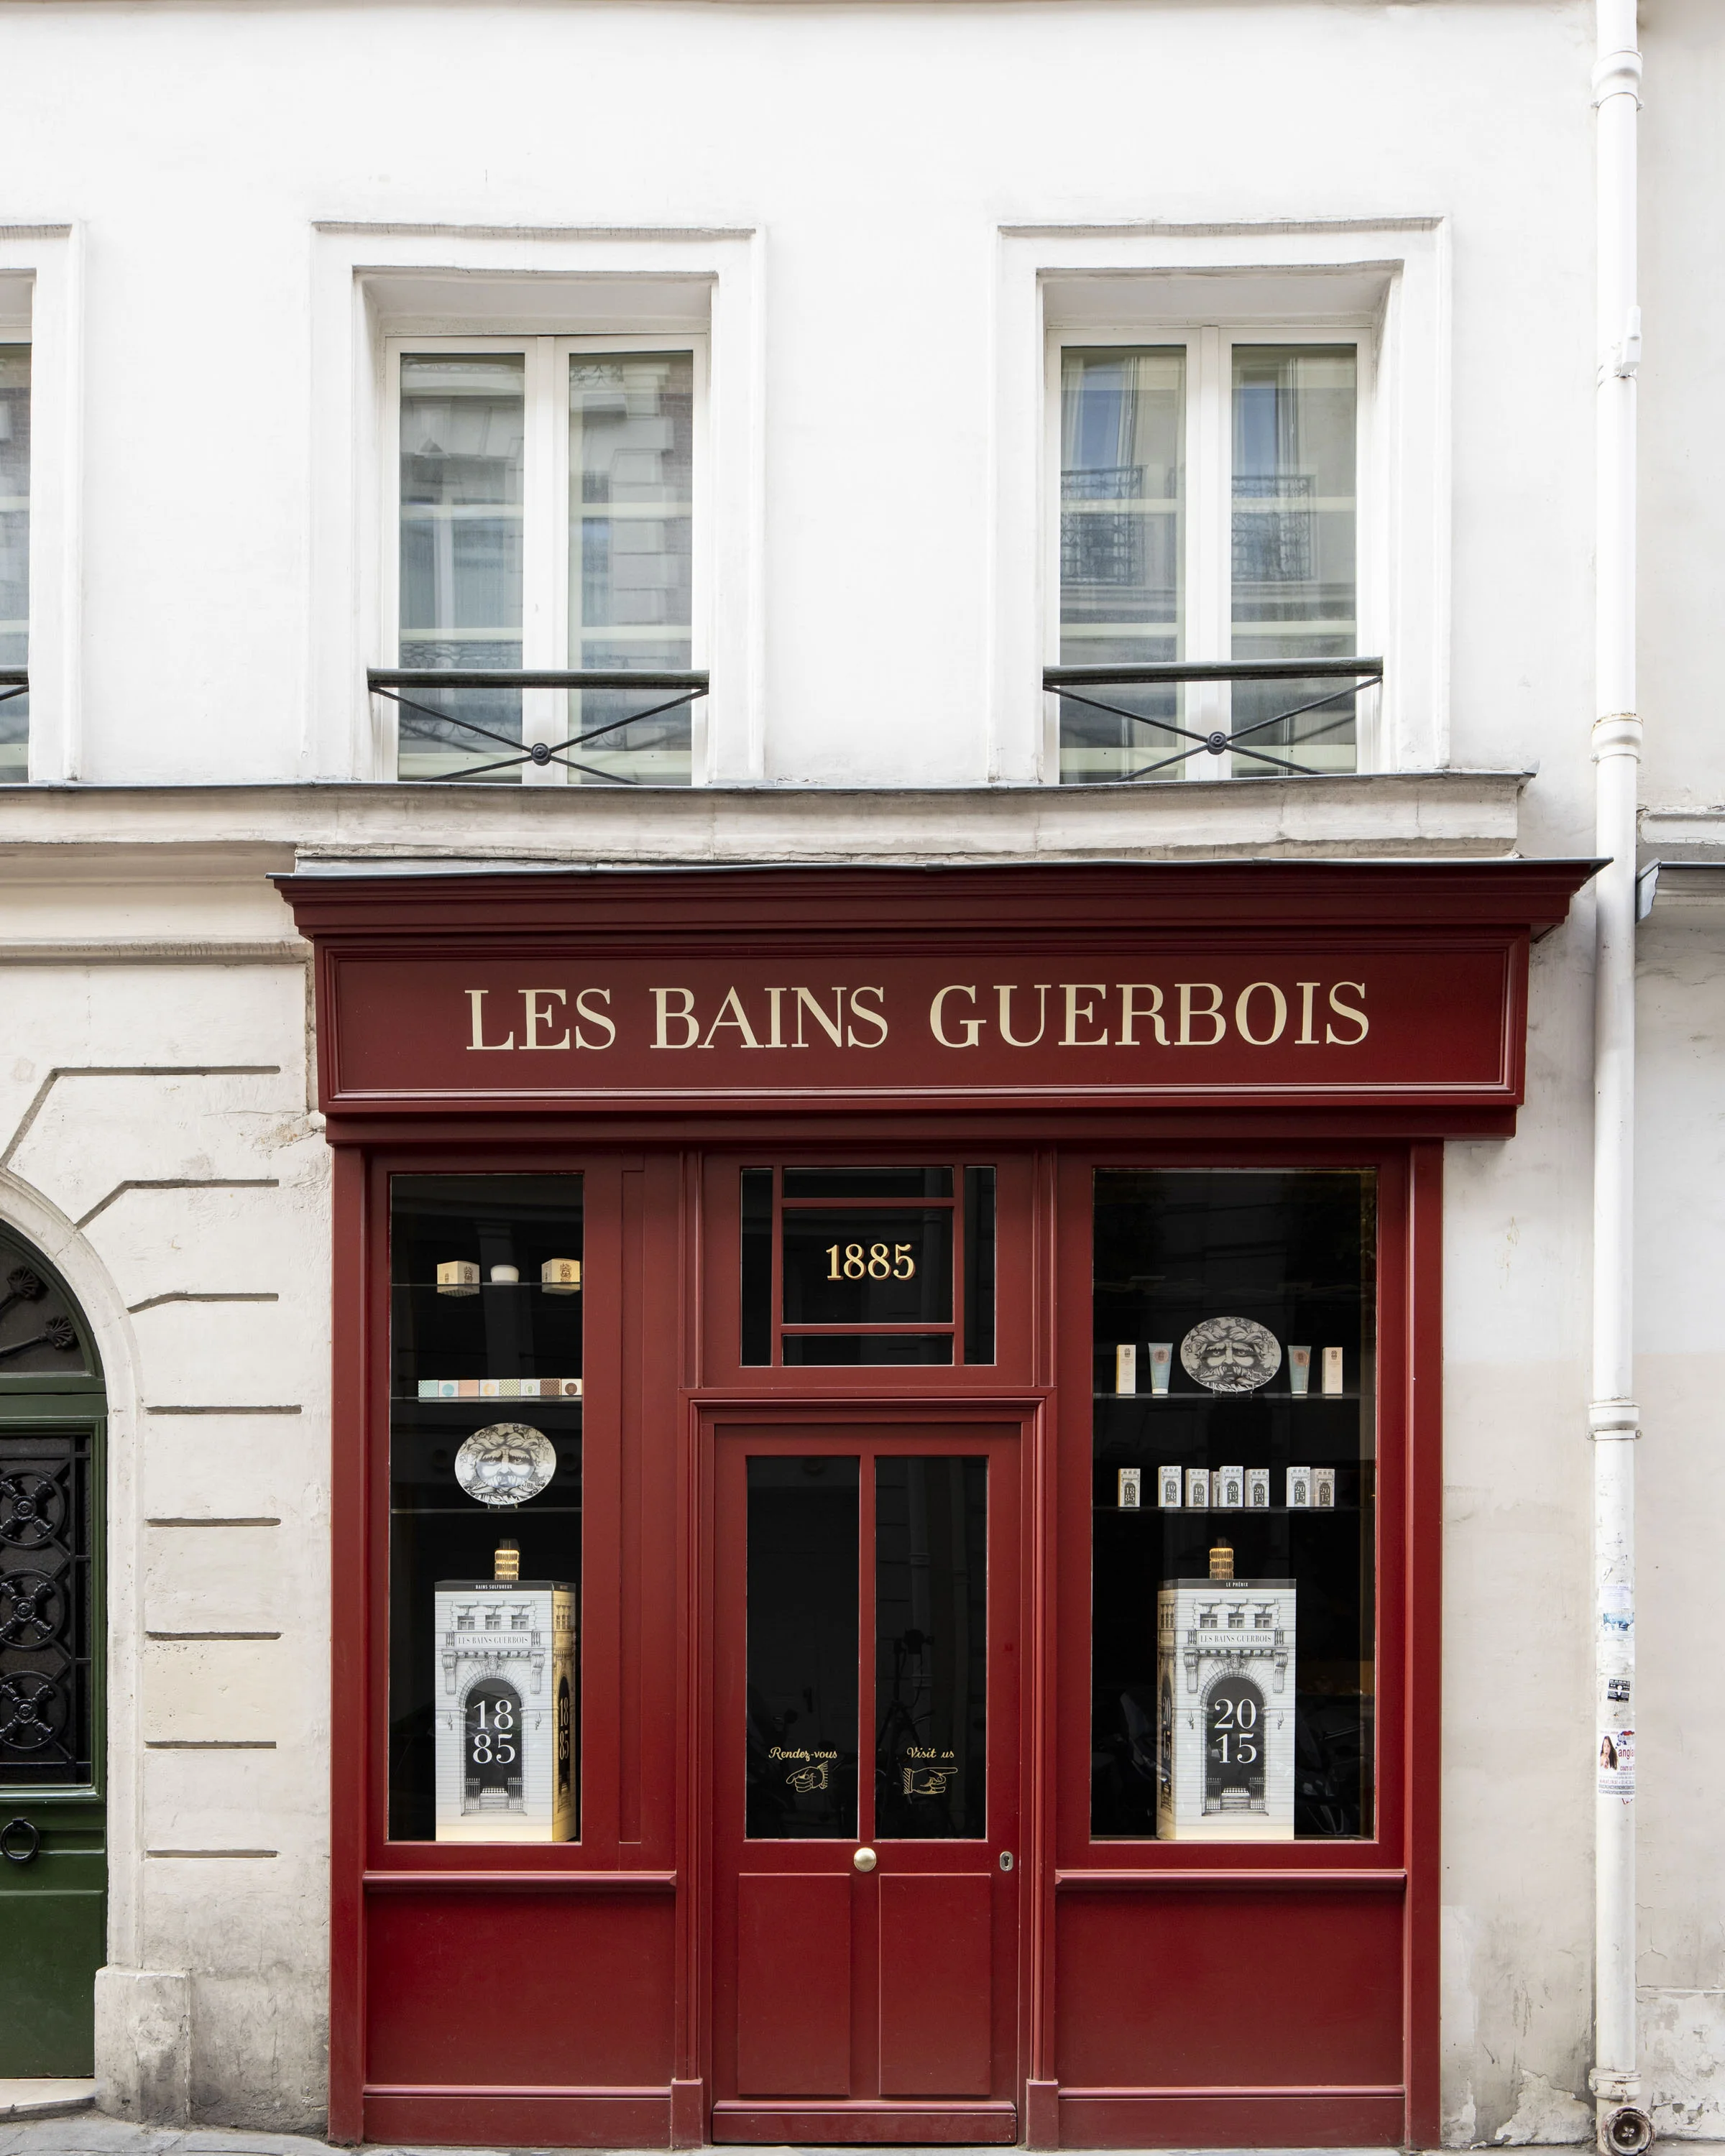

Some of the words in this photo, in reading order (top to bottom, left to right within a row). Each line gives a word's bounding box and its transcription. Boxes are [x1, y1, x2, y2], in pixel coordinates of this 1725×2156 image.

[464, 987, 616, 1050] LES
[649, 985, 888, 1049] BAINS
[929, 981, 1369, 1048] GUERBOIS
[826, 1243, 916, 1281] 1885
[473, 1700, 514, 1730] 18
[559, 1697, 569, 1726] 18
[1214, 1698, 1256, 1729] 20
[472, 1733, 515, 1764] 85
[559, 1730, 569, 1759] 85
[768, 1746, 837, 1761] Rendez-vous
[906, 1746, 937, 1759] Visit
[942, 1750, 954, 1759] us
[1215, 1733, 1257, 1764] 15
